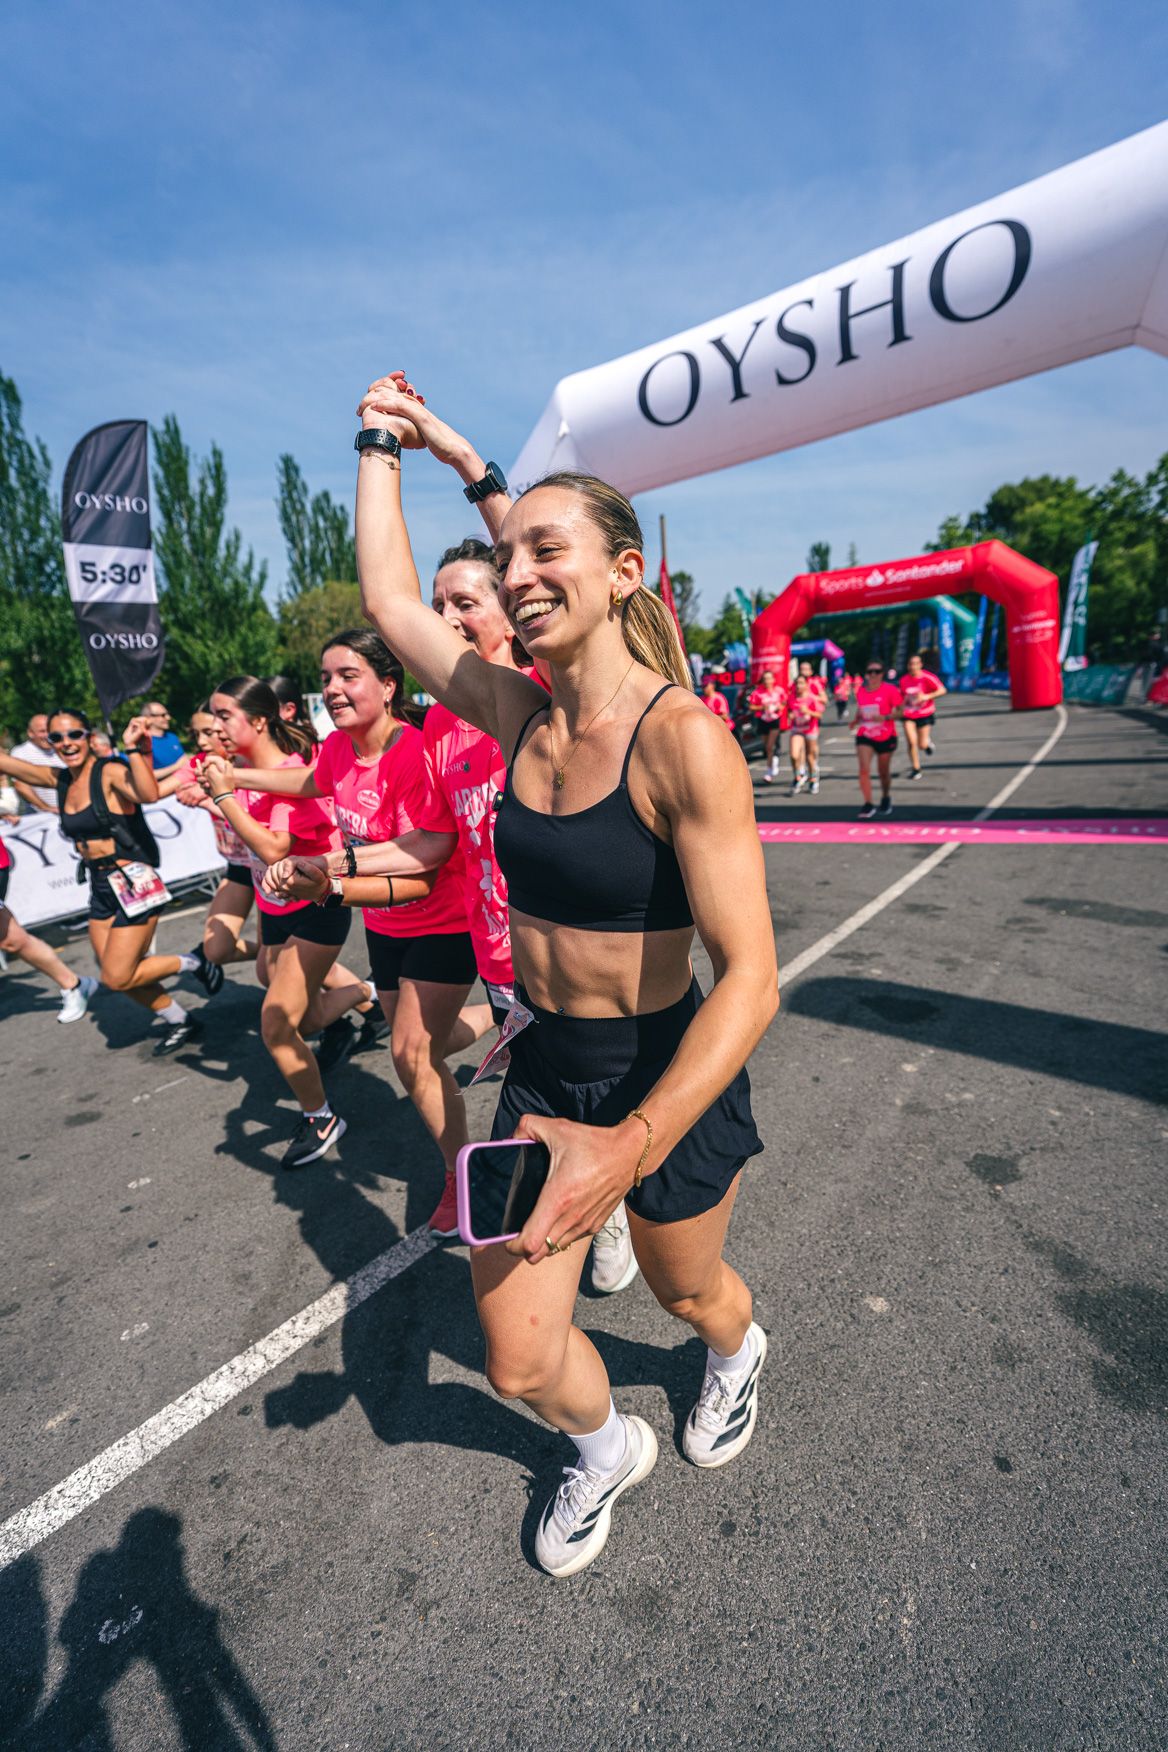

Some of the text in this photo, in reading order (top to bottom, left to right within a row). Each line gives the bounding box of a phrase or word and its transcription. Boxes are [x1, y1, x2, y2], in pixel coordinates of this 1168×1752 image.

[638, 219, 1032, 427] OYSHO
[74, 490, 148, 515] OYSHO
[819, 576, 864, 595] Sports
[885, 559, 965, 585] Santander
[89, 632, 159, 650] OYSHO
